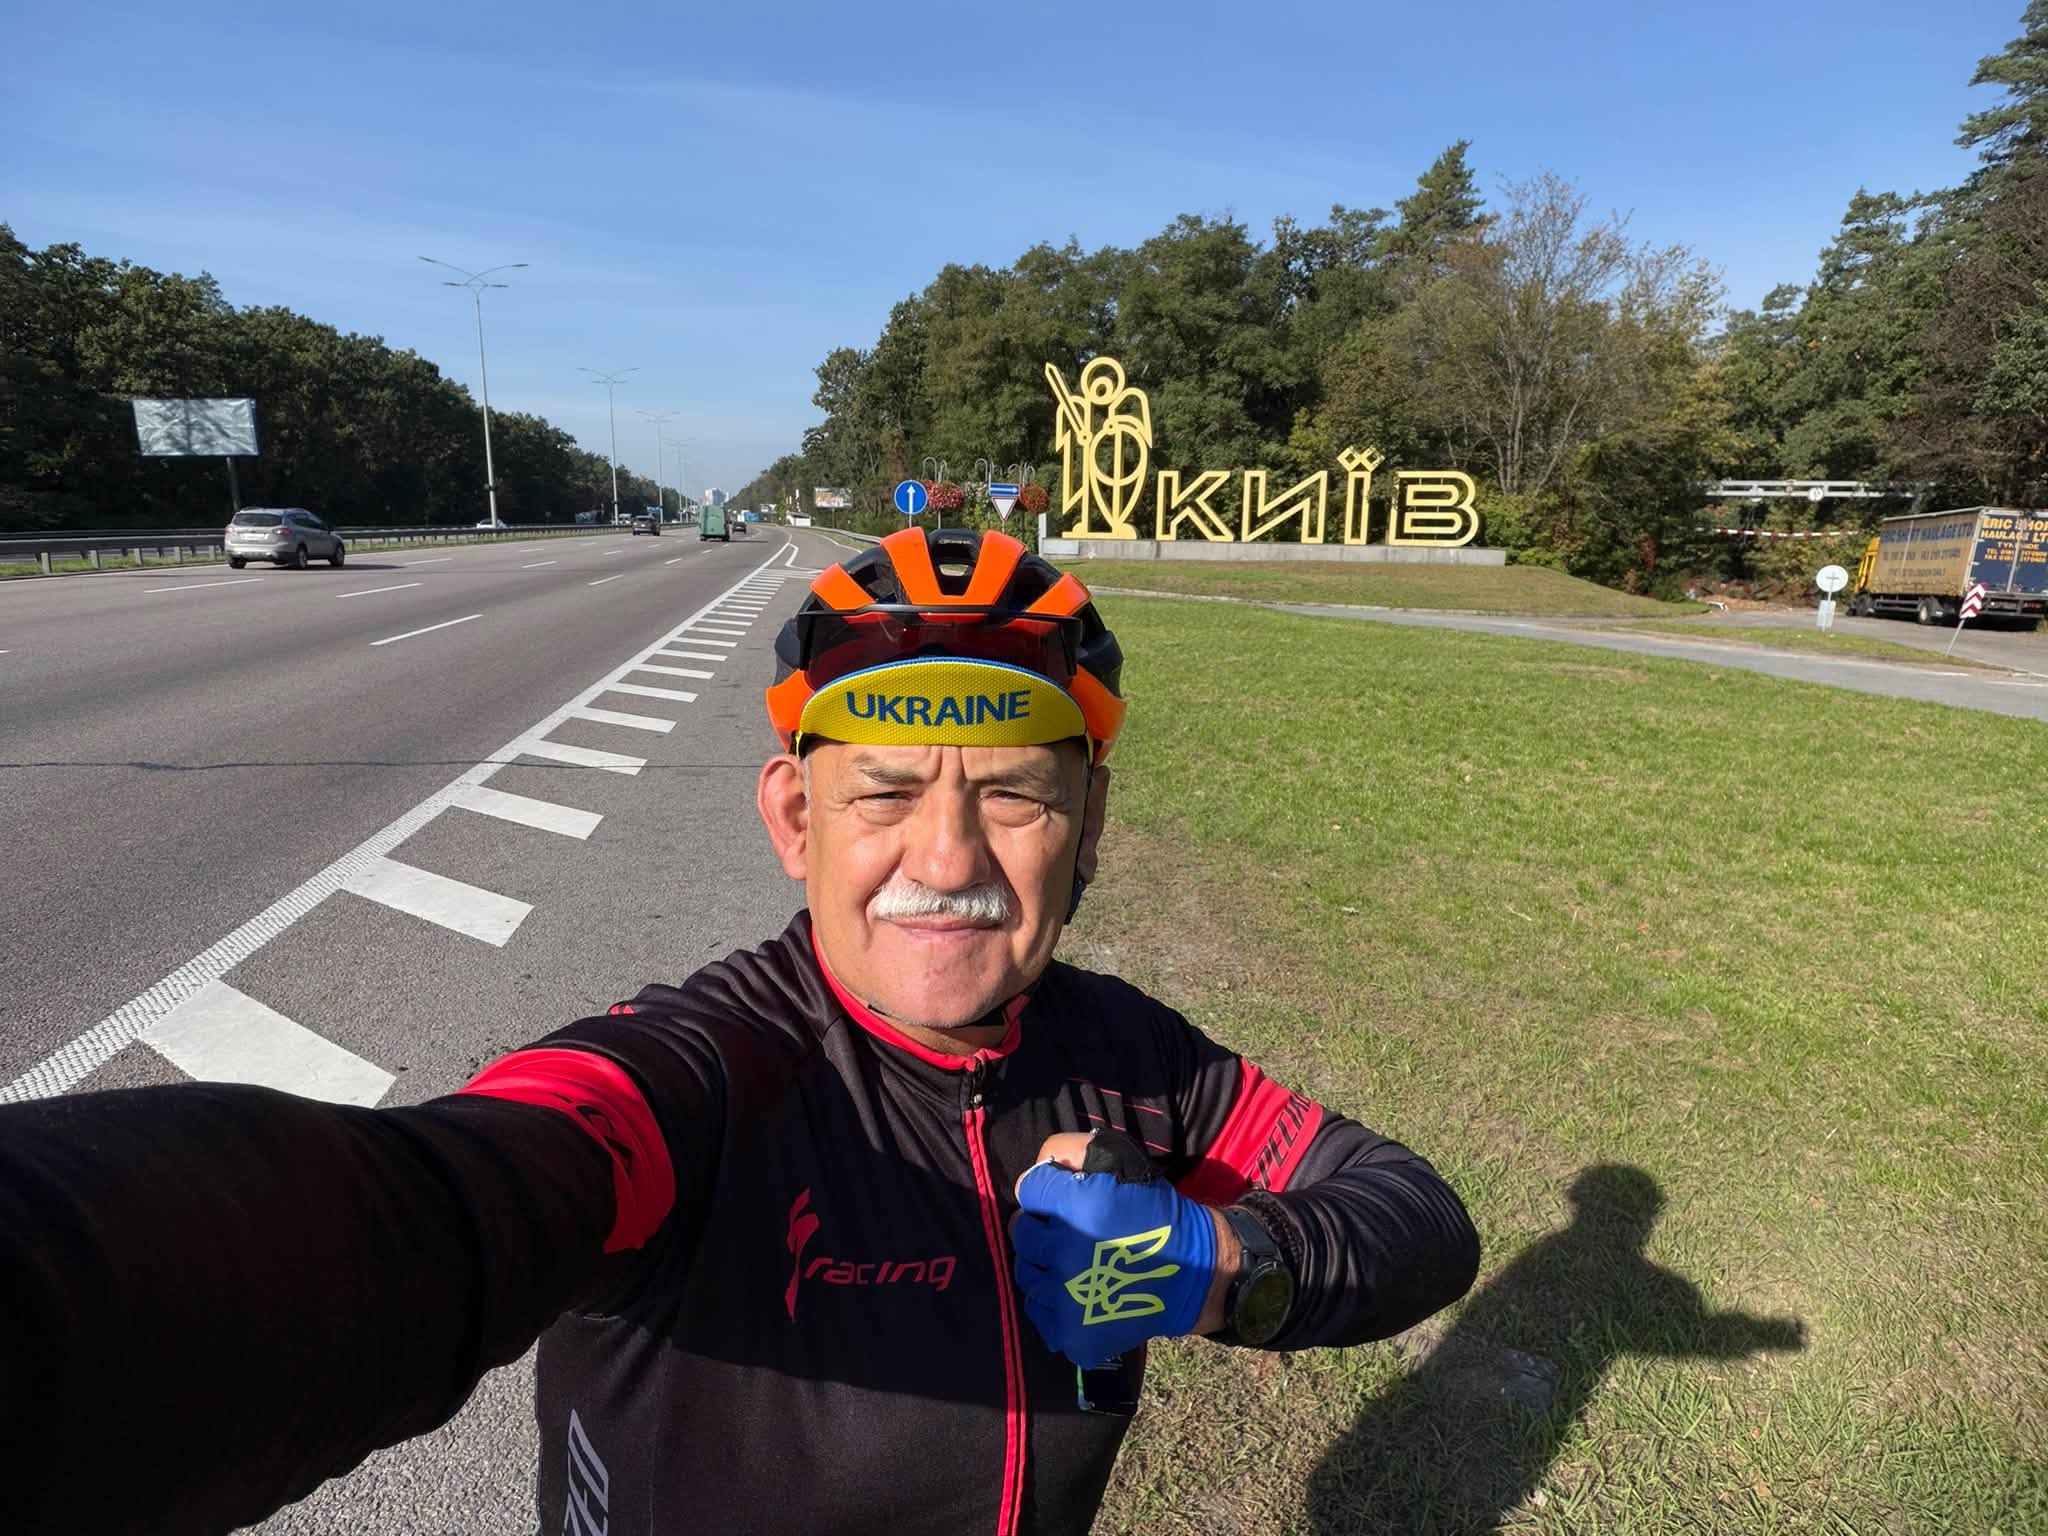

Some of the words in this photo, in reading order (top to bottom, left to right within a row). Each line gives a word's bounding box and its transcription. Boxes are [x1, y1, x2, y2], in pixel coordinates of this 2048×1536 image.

[1156, 446, 1479, 547] КИЇВ
[846, 690, 1031, 727] UKRAINE
[803, 1255, 957, 1292] racing
